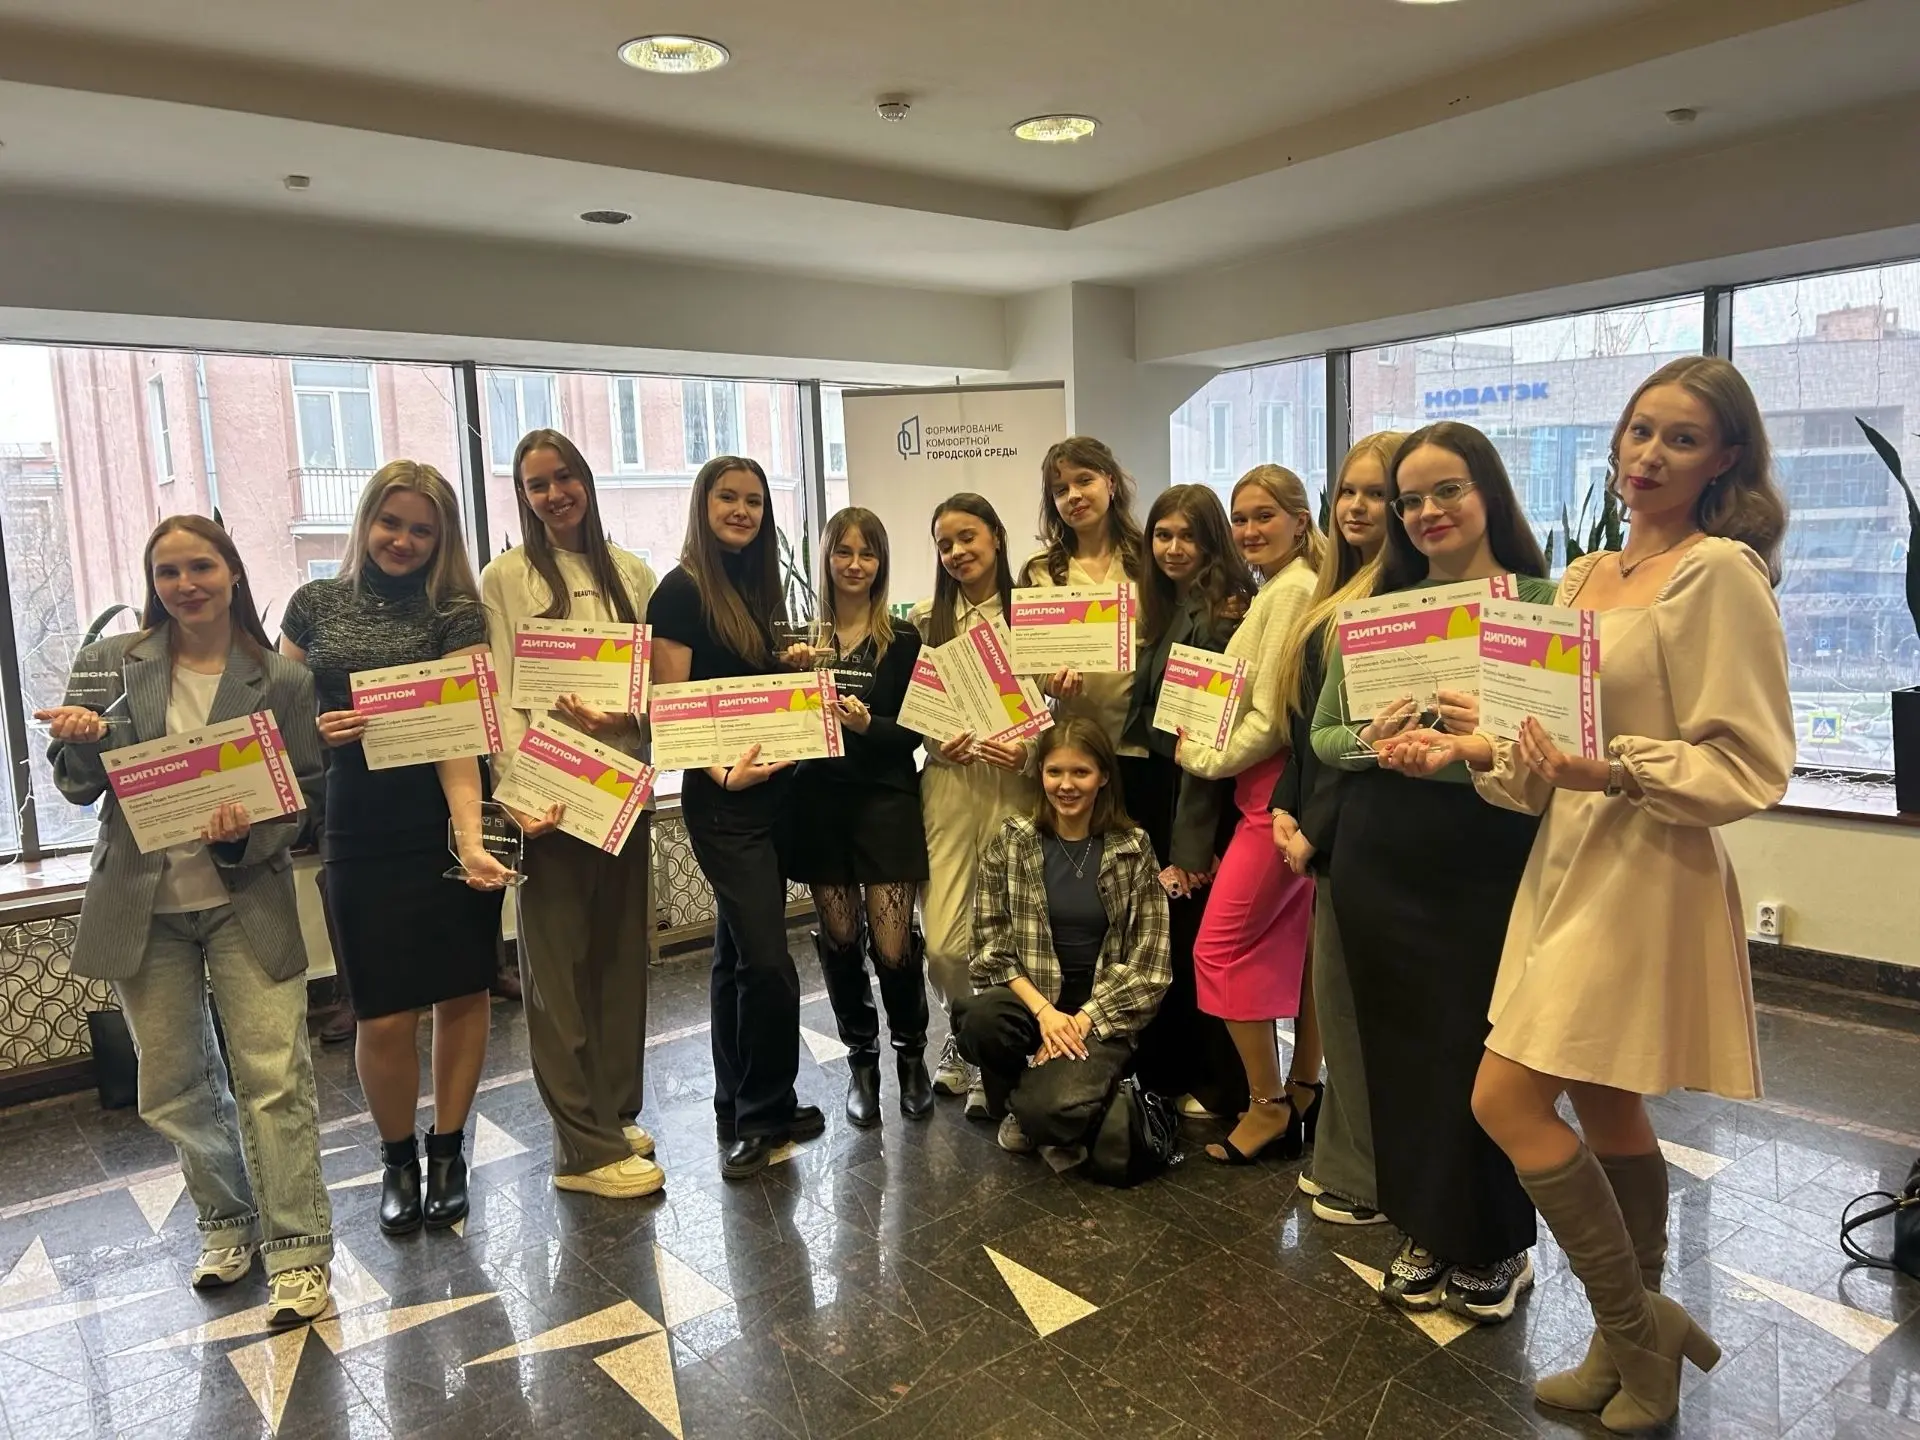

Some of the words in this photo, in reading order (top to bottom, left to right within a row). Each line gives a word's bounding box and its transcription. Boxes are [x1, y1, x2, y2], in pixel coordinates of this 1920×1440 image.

[1424, 382, 1549, 408] НОВАТЭК
[925, 423, 1004, 436] ФОРМИРОВАНИЕ
[926, 435, 990, 448] КОМФОРТНОЙ
[926, 448, 983, 460] ГОРОДСКОЙ
[984, 447, 1018, 458] СРЕДЫ
[1016, 607, 1065, 616] ДИПЛОМ
[1347, 621, 1416, 641] ДИПЛОМ
[1484, 631, 1526, 648] ДИПЛОМ
[521, 639, 576, 649] ДИПЛОМ
[980, 629, 1007, 674] ДИПЛОМ
[918, 666, 937, 677] ДИП
[1169, 664, 1199, 677] ДИПЛОМ
[1582, 610, 1595, 760] СТУДВЕСНА
[358, 688, 416, 705] ДИПЛОМ
[474, 653, 501, 753] СТУДВЕСНА
[655, 701, 708, 713] ДИПЛОМ
[718, 696, 769, 707] ДИПЛОМ
[529, 736, 583, 765] ДИПЛОМ
[252, 712, 297, 814] СТУДВЕСНА
[119, 759, 189, 786] ДИПЛОМ
[604, 767, 654, 853] СТУДВЕСНА
